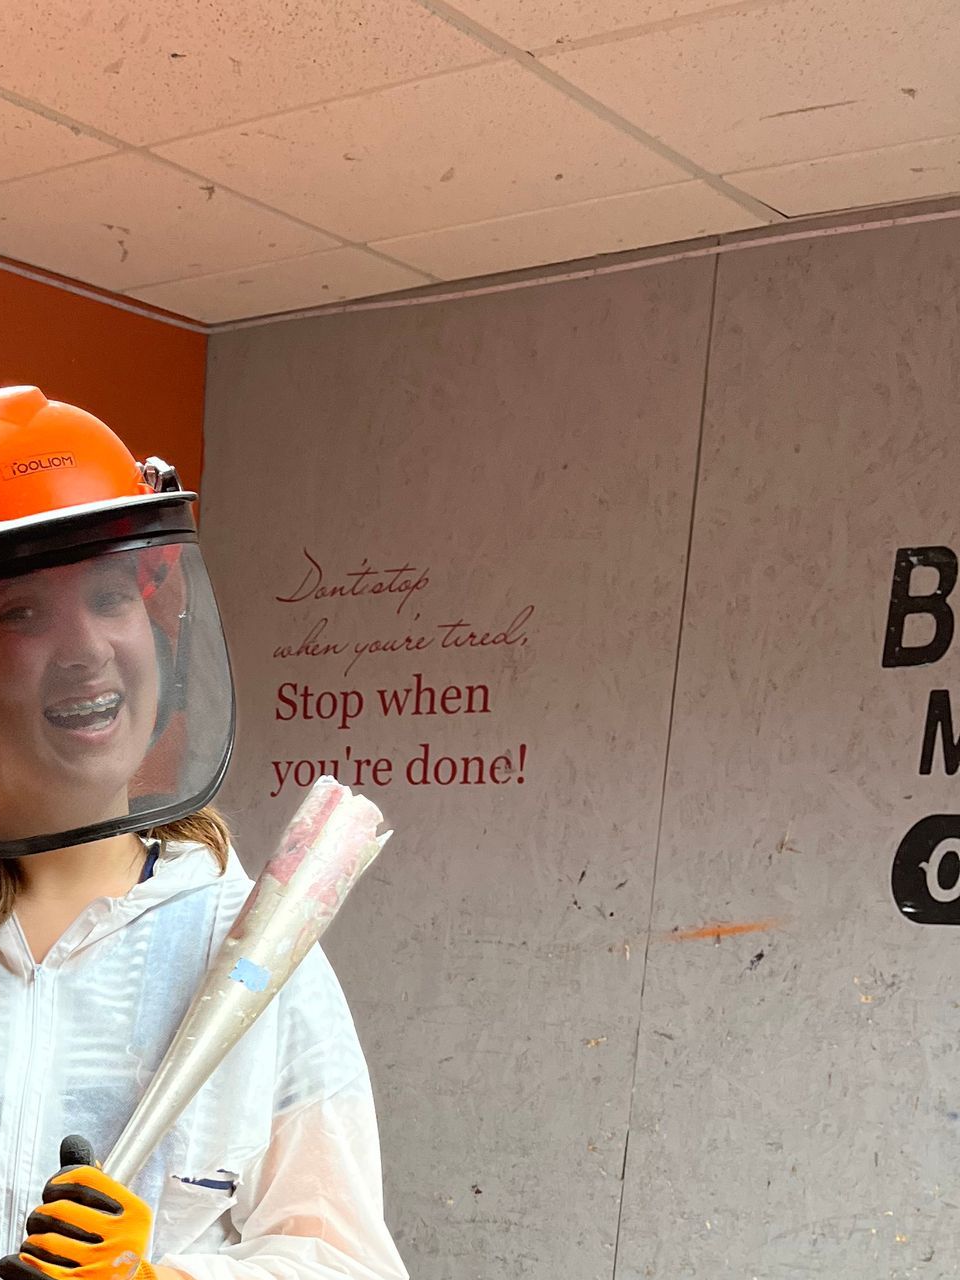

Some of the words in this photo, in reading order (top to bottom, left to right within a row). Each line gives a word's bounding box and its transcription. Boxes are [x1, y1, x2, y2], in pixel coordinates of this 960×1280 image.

[276, 547, 378, 602] Don't
[370, 563, 430, 614] stop
[273, 618, 349, 659] when
[345, 613, 435, 677] you're
[437, 605, 535, 647] tired,
[275, 682, 364, 729] Stop
[376, 673, 491, 717] when
[406, 744, 527, 786] done!
